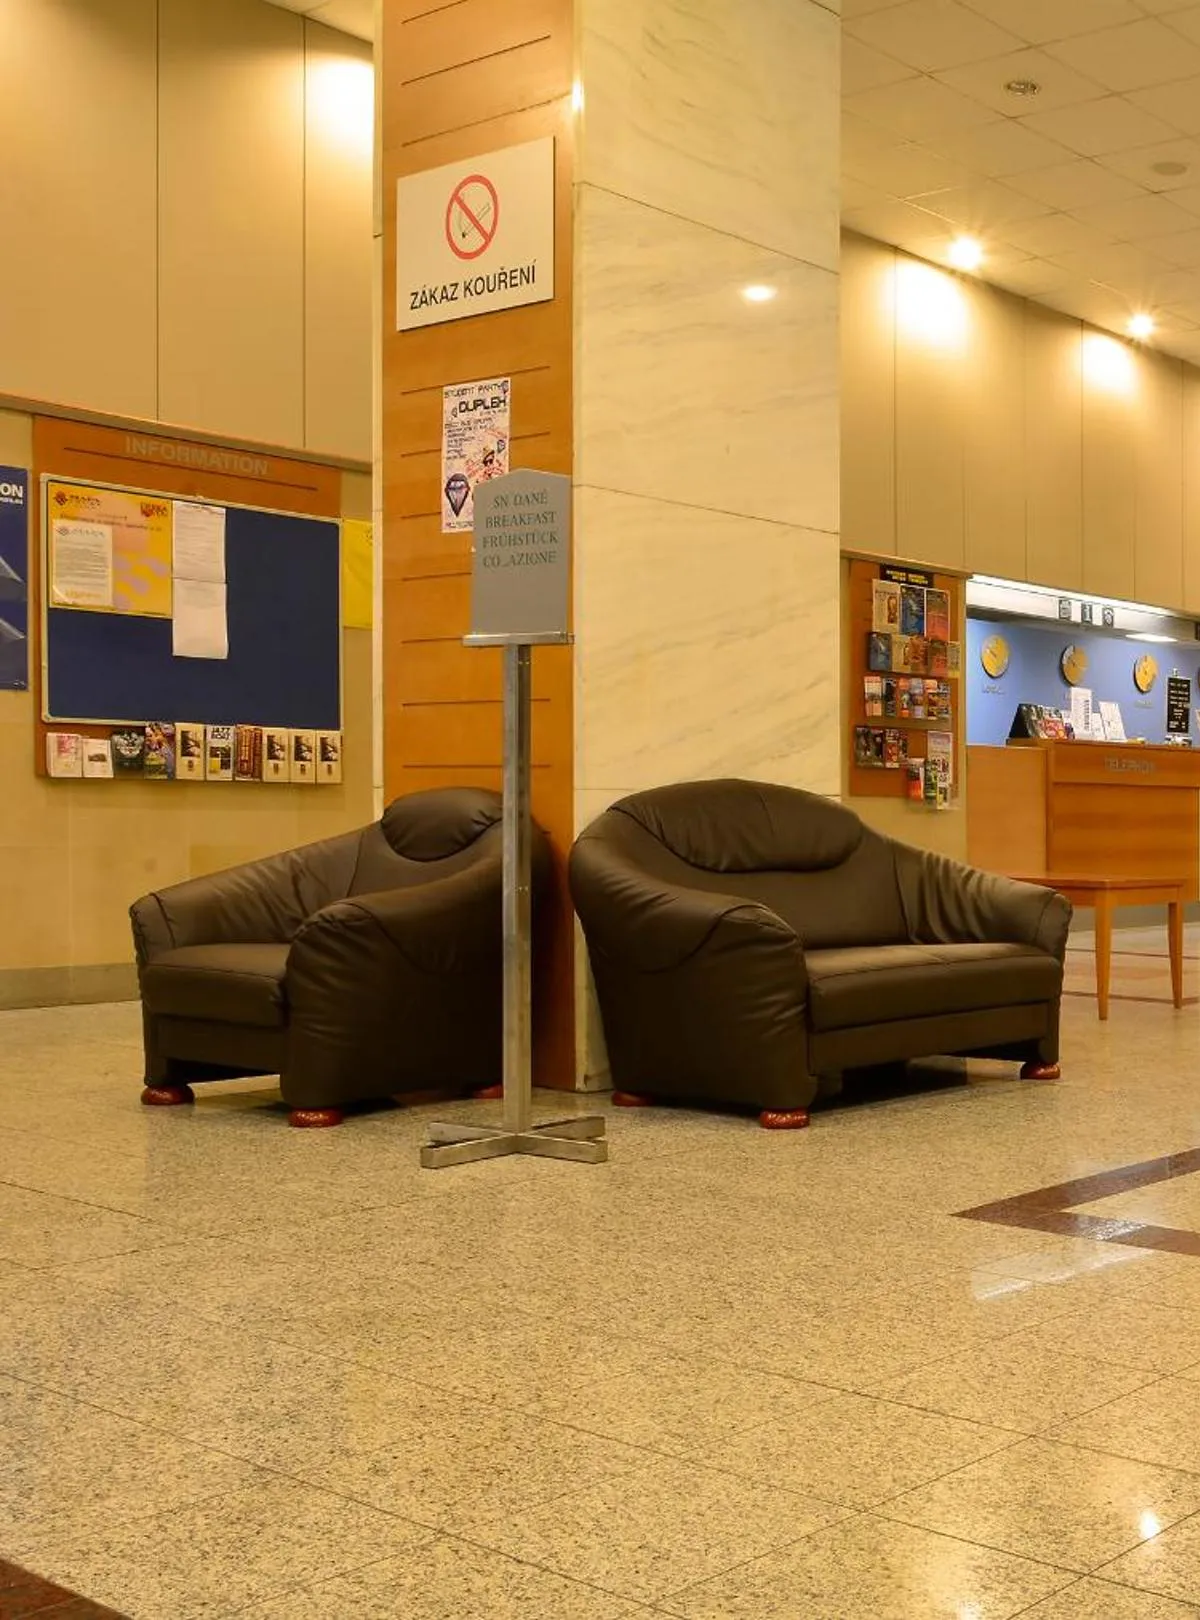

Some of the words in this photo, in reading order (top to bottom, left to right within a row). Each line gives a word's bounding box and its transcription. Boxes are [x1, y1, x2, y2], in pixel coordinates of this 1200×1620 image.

[410, 282, 459, 310] ZÁKAZ
[463, 259, 537, 298] KOUŘENÍ
[125, 435, 269, 475] INFORMATION
[485, 511, 557, 529] BREAKFAST
[482, 530, 558, 549] FRÜHSTÜCK
